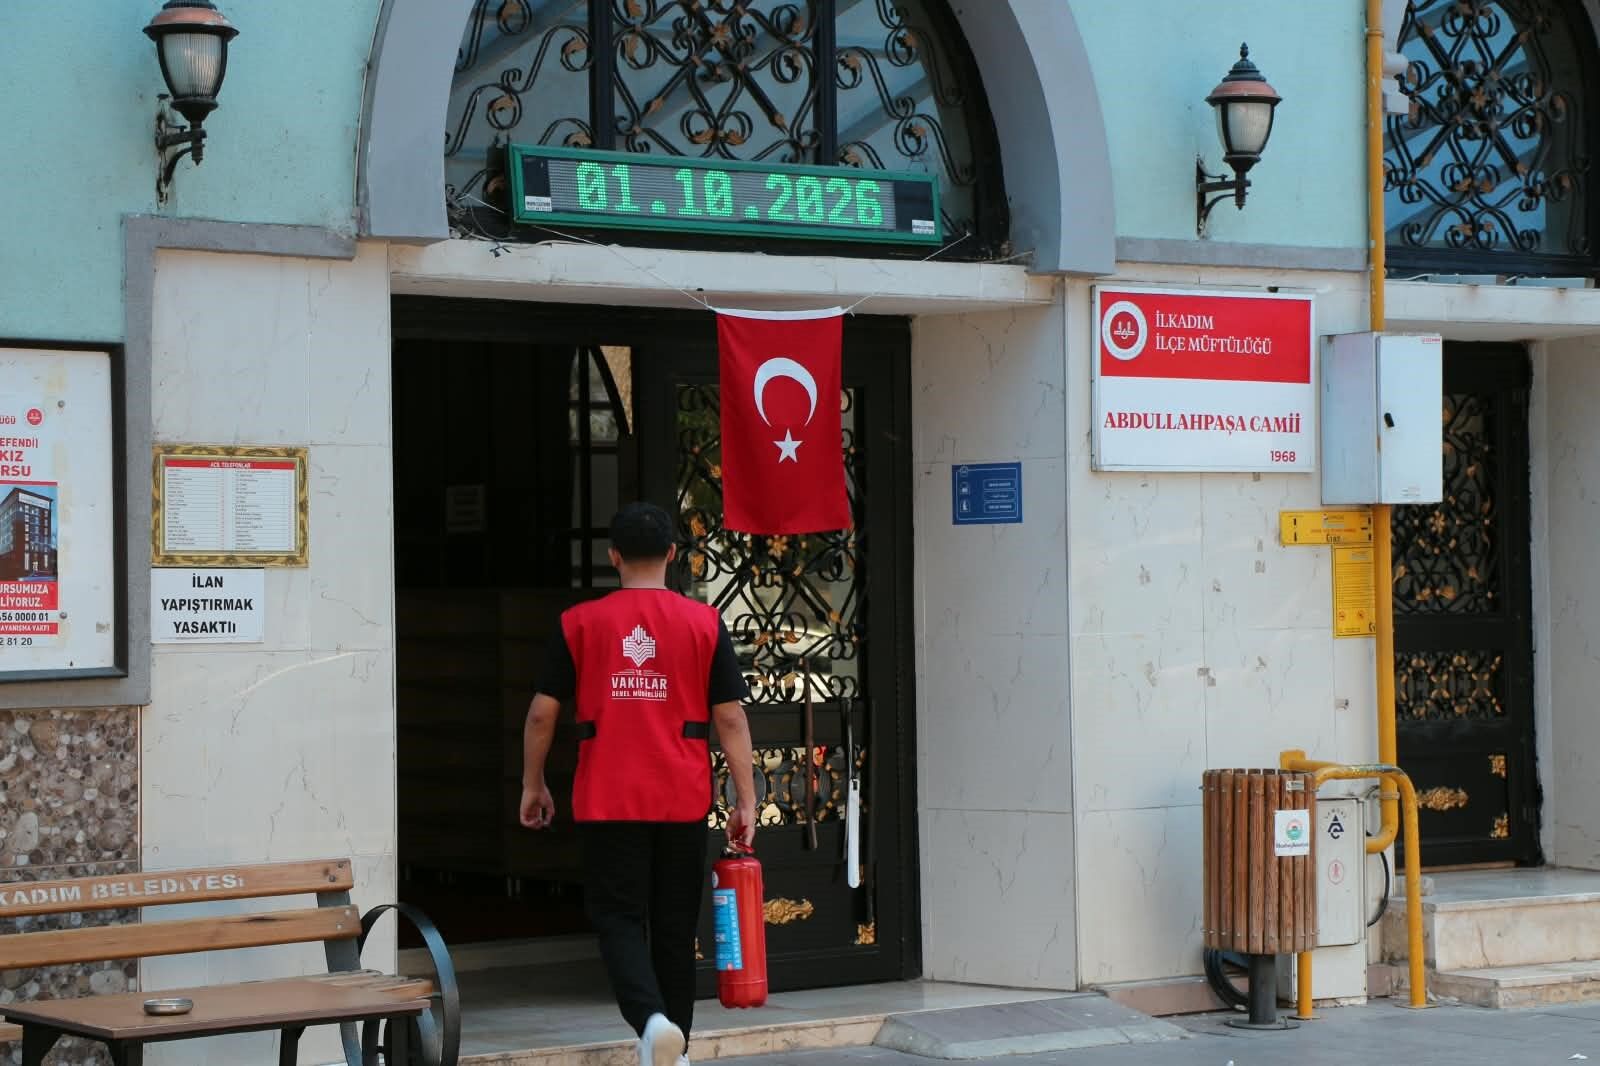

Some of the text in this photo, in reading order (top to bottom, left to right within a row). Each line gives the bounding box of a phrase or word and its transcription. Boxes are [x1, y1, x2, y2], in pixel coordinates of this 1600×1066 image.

[576, 162, 884, 226] 01.10.2026
[1155, 310, 1214, 330] İLKADIM
[1155, 333, 1272, 355] İLÇE MÜFTÜLÜĞÜ
[1104, 412, 1302, 436] ABDULLAHPAŞA CAMİİ
[1271, 450, 1297, 463] 1968
[192, 573, 223, 588] İLAN
[161, 598, 253, 614] YAPIŞTIRMAK
[15, 612, 37, 621] 0000
[38, 612, 49, 621] 01
[7, 637, 17, 646] 81
[21, 637, 33, 646] 20
[611, 676, 667, 690] VAKIFLAR
